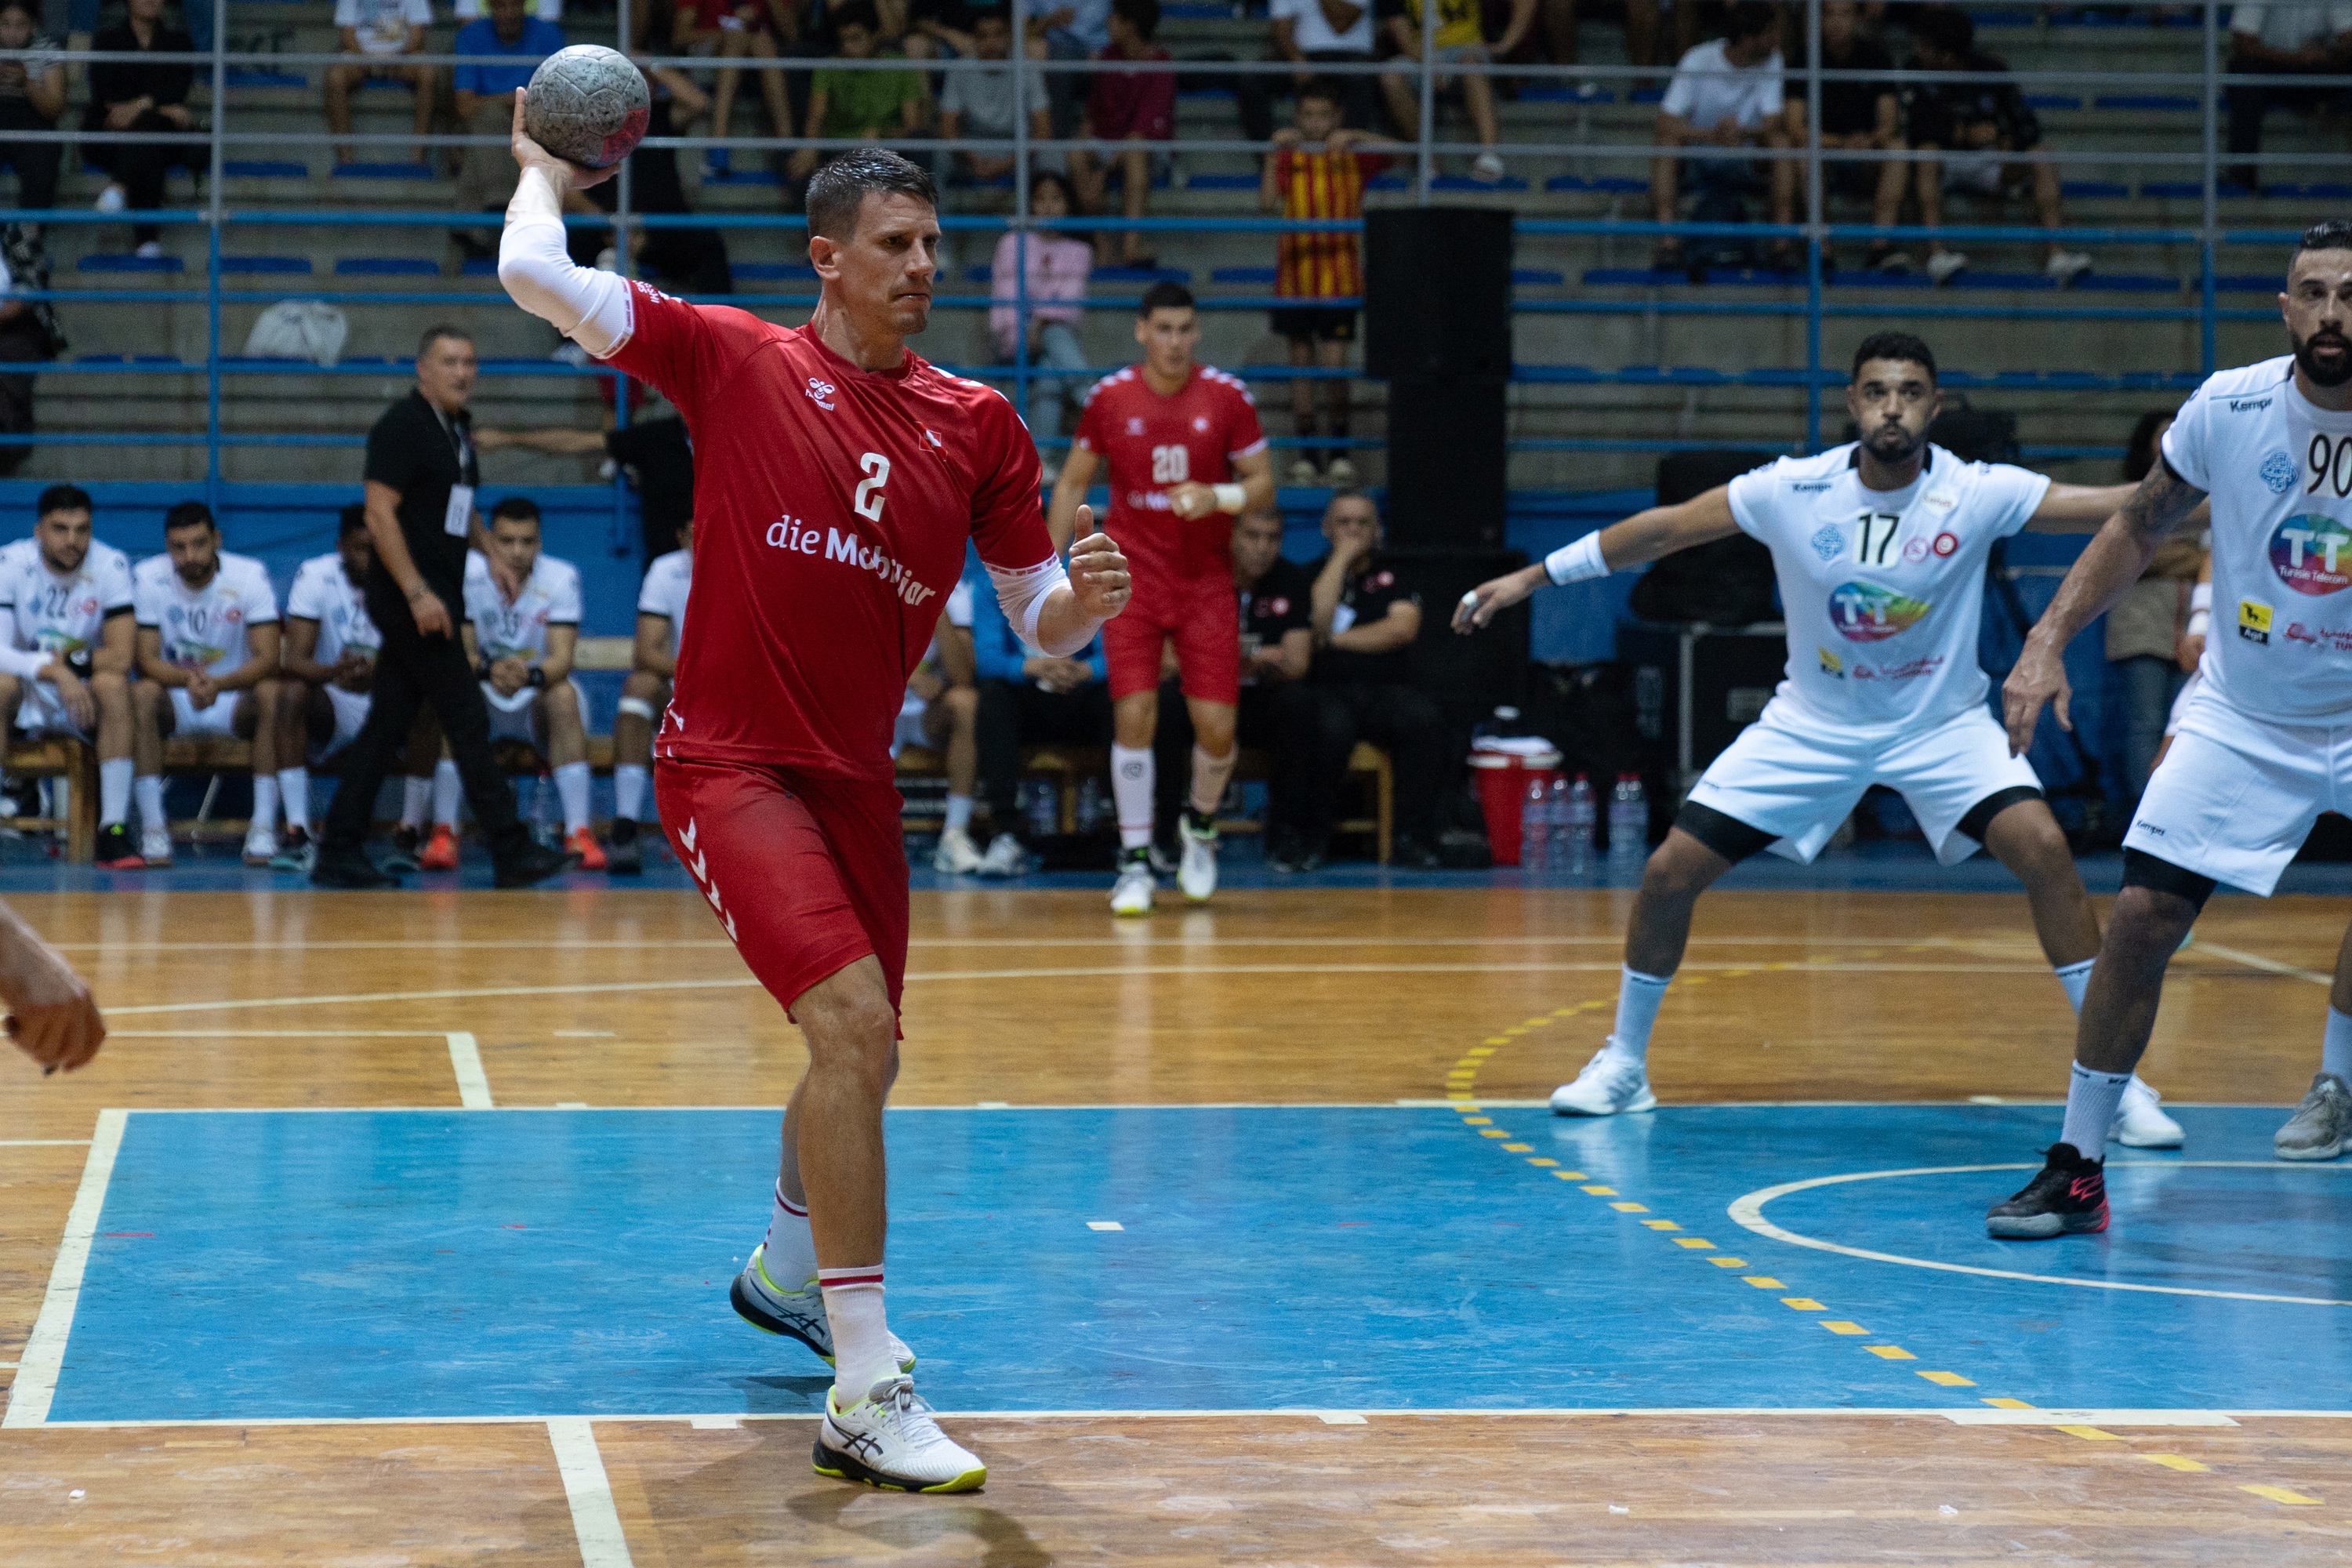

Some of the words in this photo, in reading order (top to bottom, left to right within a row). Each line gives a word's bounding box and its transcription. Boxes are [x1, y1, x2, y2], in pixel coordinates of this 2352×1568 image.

[1152, 444, 1190, 484] 20
[2307, 434, 2352, 498] 90
[854, 452, 891, 523] 2
[766, 514, 821, 555] die
[1859, 514, 1900, 564] 17
[2280, 528, 2350, 574] TT
[45, 586, 70, 618] 22
[187, 608, 207, 634] 10
[1835, 593, 1893, 625] TT
